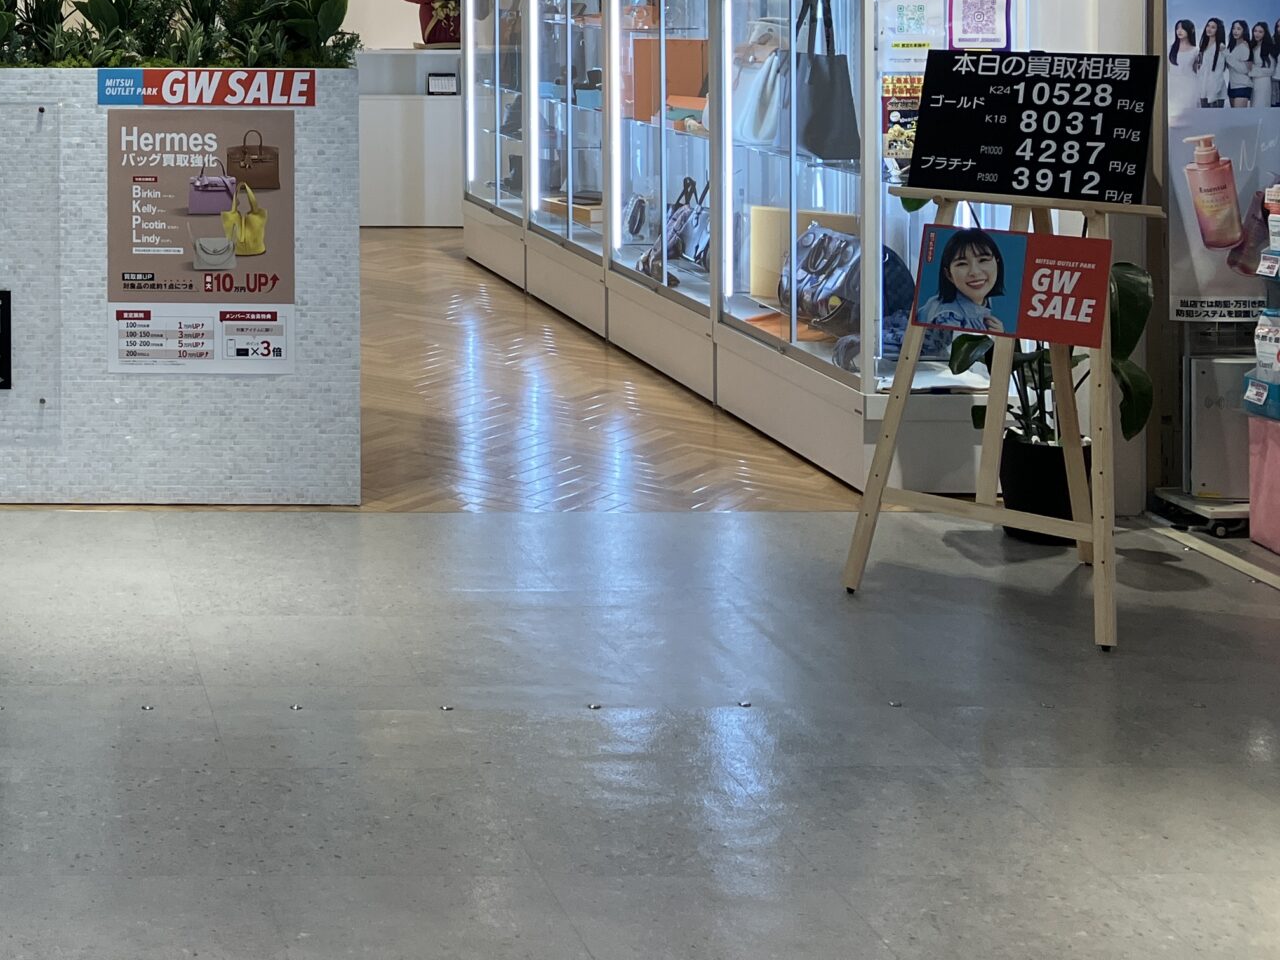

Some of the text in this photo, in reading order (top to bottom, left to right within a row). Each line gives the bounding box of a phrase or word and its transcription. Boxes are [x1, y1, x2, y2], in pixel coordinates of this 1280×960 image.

[952, 53, 1131, 81] 本日の買取相場
[105, 78, 134, 87] MITSUI
[105, 87, 158, 96] OUTLET PARK
[161, 70, 311, 105] GW SALE
[930, 94, 985, 110] ゴールド
[989, 81, 1145, 113] K24 10528 円/g
[985, 110, 1141, 141] K18 8031 円/g
[120, 126, 218, 152] Hermes
[121, 153, 219, 168] バッグ買取強化
[920, 155, 977, 171] プラチナ
[980, 138, 1136, 175] Pt1000 4287 円/g
[132, 185, 161, 198] Birkin
[976, 166, 1133, 204] Pt900 3912 円/g
[132, 200, 157, 215] Kelly
[132, 215, 166, 229] Picotin
[132, 230, 161, 245] Lindy
[1031, 268, 1082, 295] GW
[1026, 293, 1097, 323] SALE
